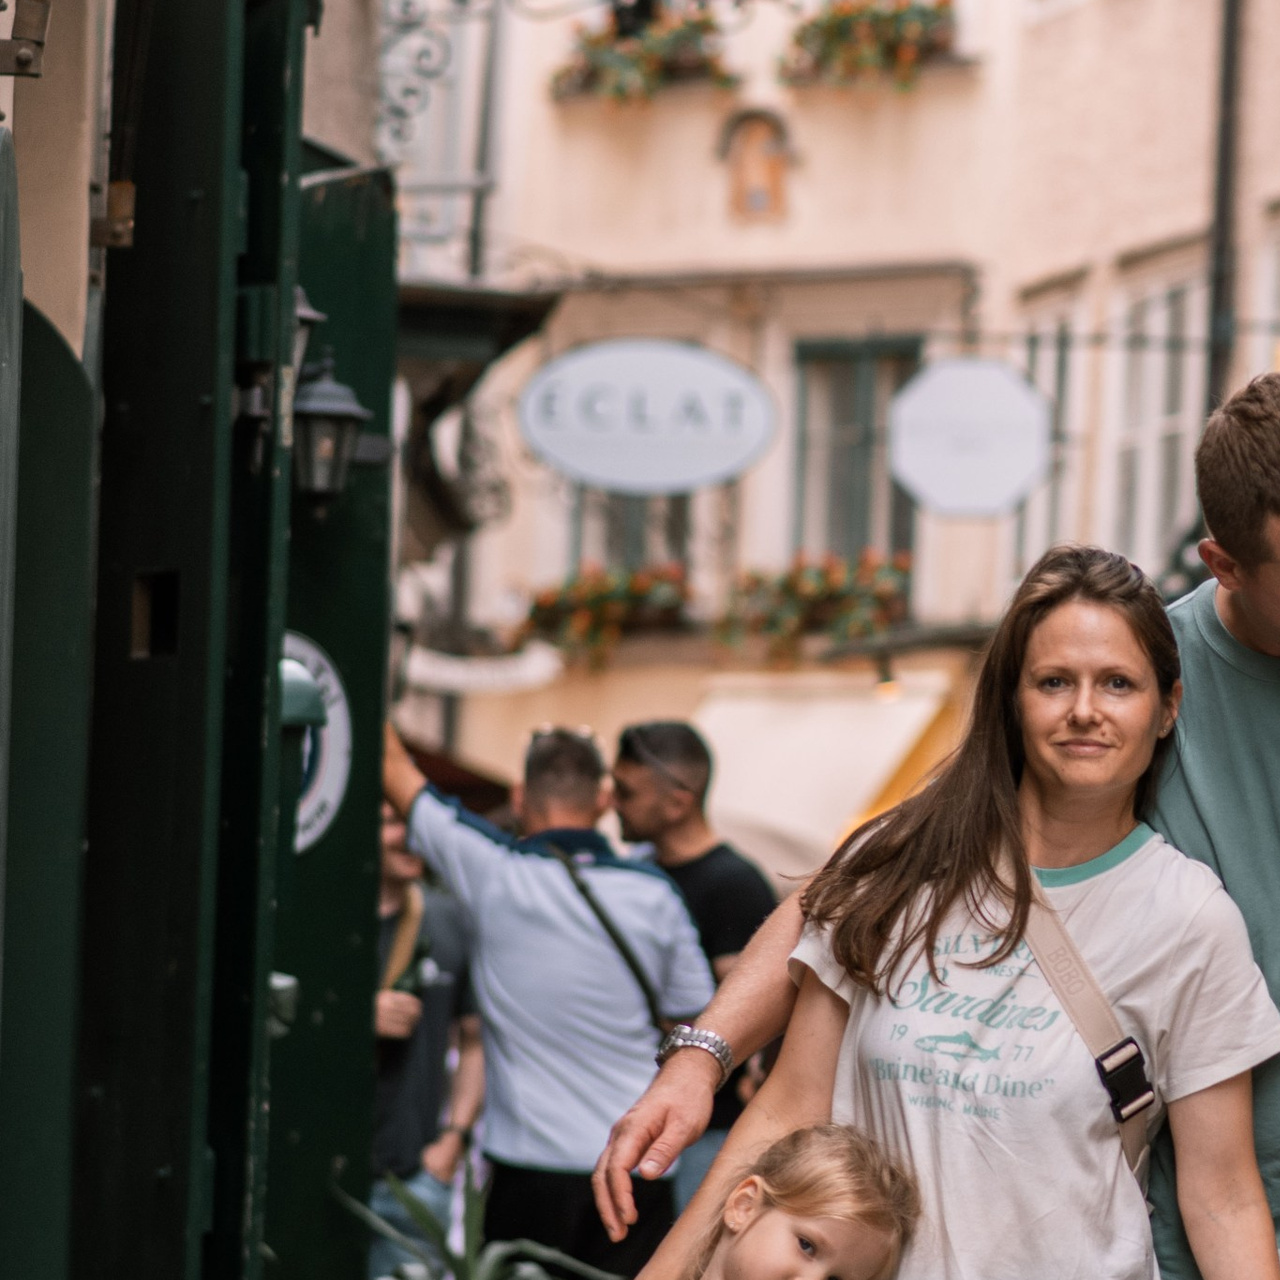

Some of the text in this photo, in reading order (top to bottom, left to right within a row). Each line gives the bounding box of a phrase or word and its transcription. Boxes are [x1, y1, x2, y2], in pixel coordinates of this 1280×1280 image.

[892, 967, 1061, 1032] Sardines
[890, 1024, 1035, 1062] 19 77
